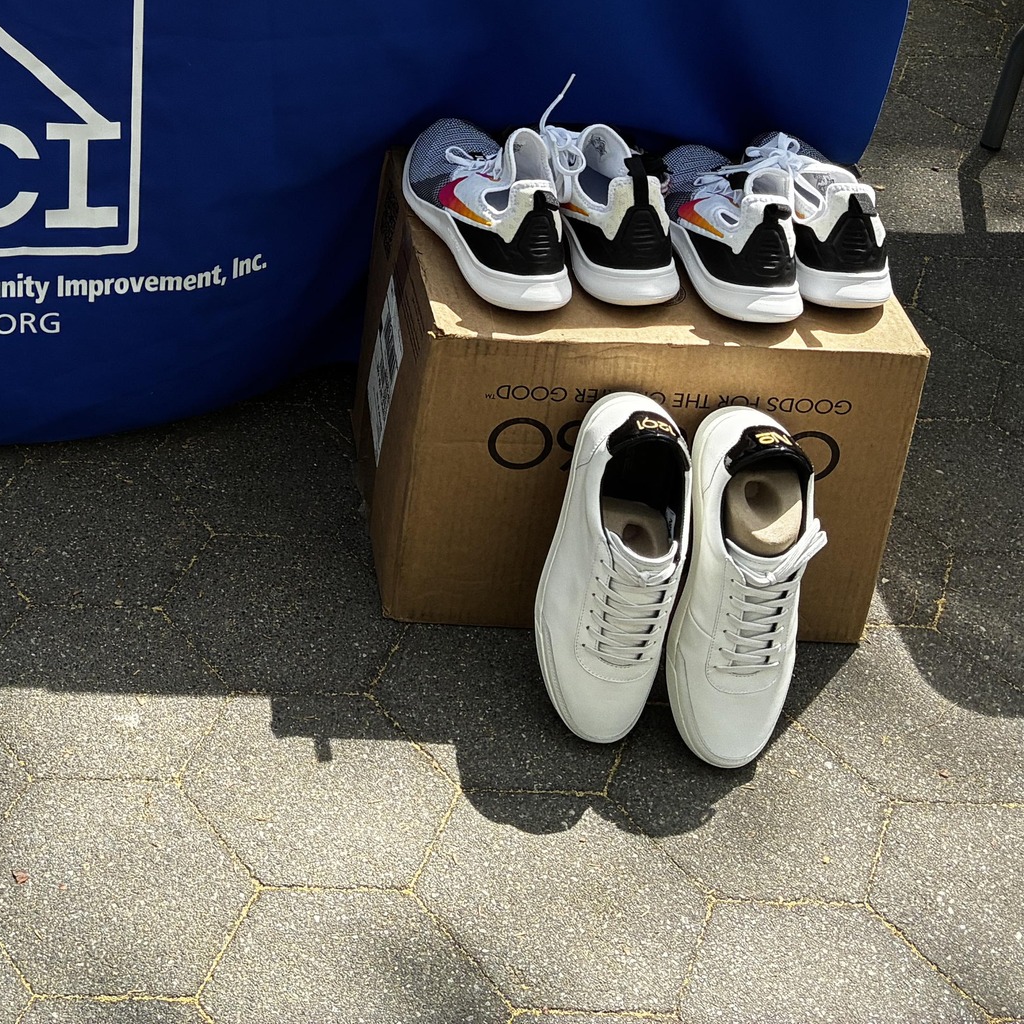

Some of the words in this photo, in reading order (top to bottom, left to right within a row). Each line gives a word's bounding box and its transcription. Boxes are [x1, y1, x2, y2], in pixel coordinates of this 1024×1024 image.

[57, 265, 228, 303] Improvement,
[232, 252, 268, 282] Inc.
[674, 392, 709, 409] THE
[718, 394, 760, 409] FOR
[767, 396, 852, 415] GOODS
[636, 416, 678, 436] 1291
